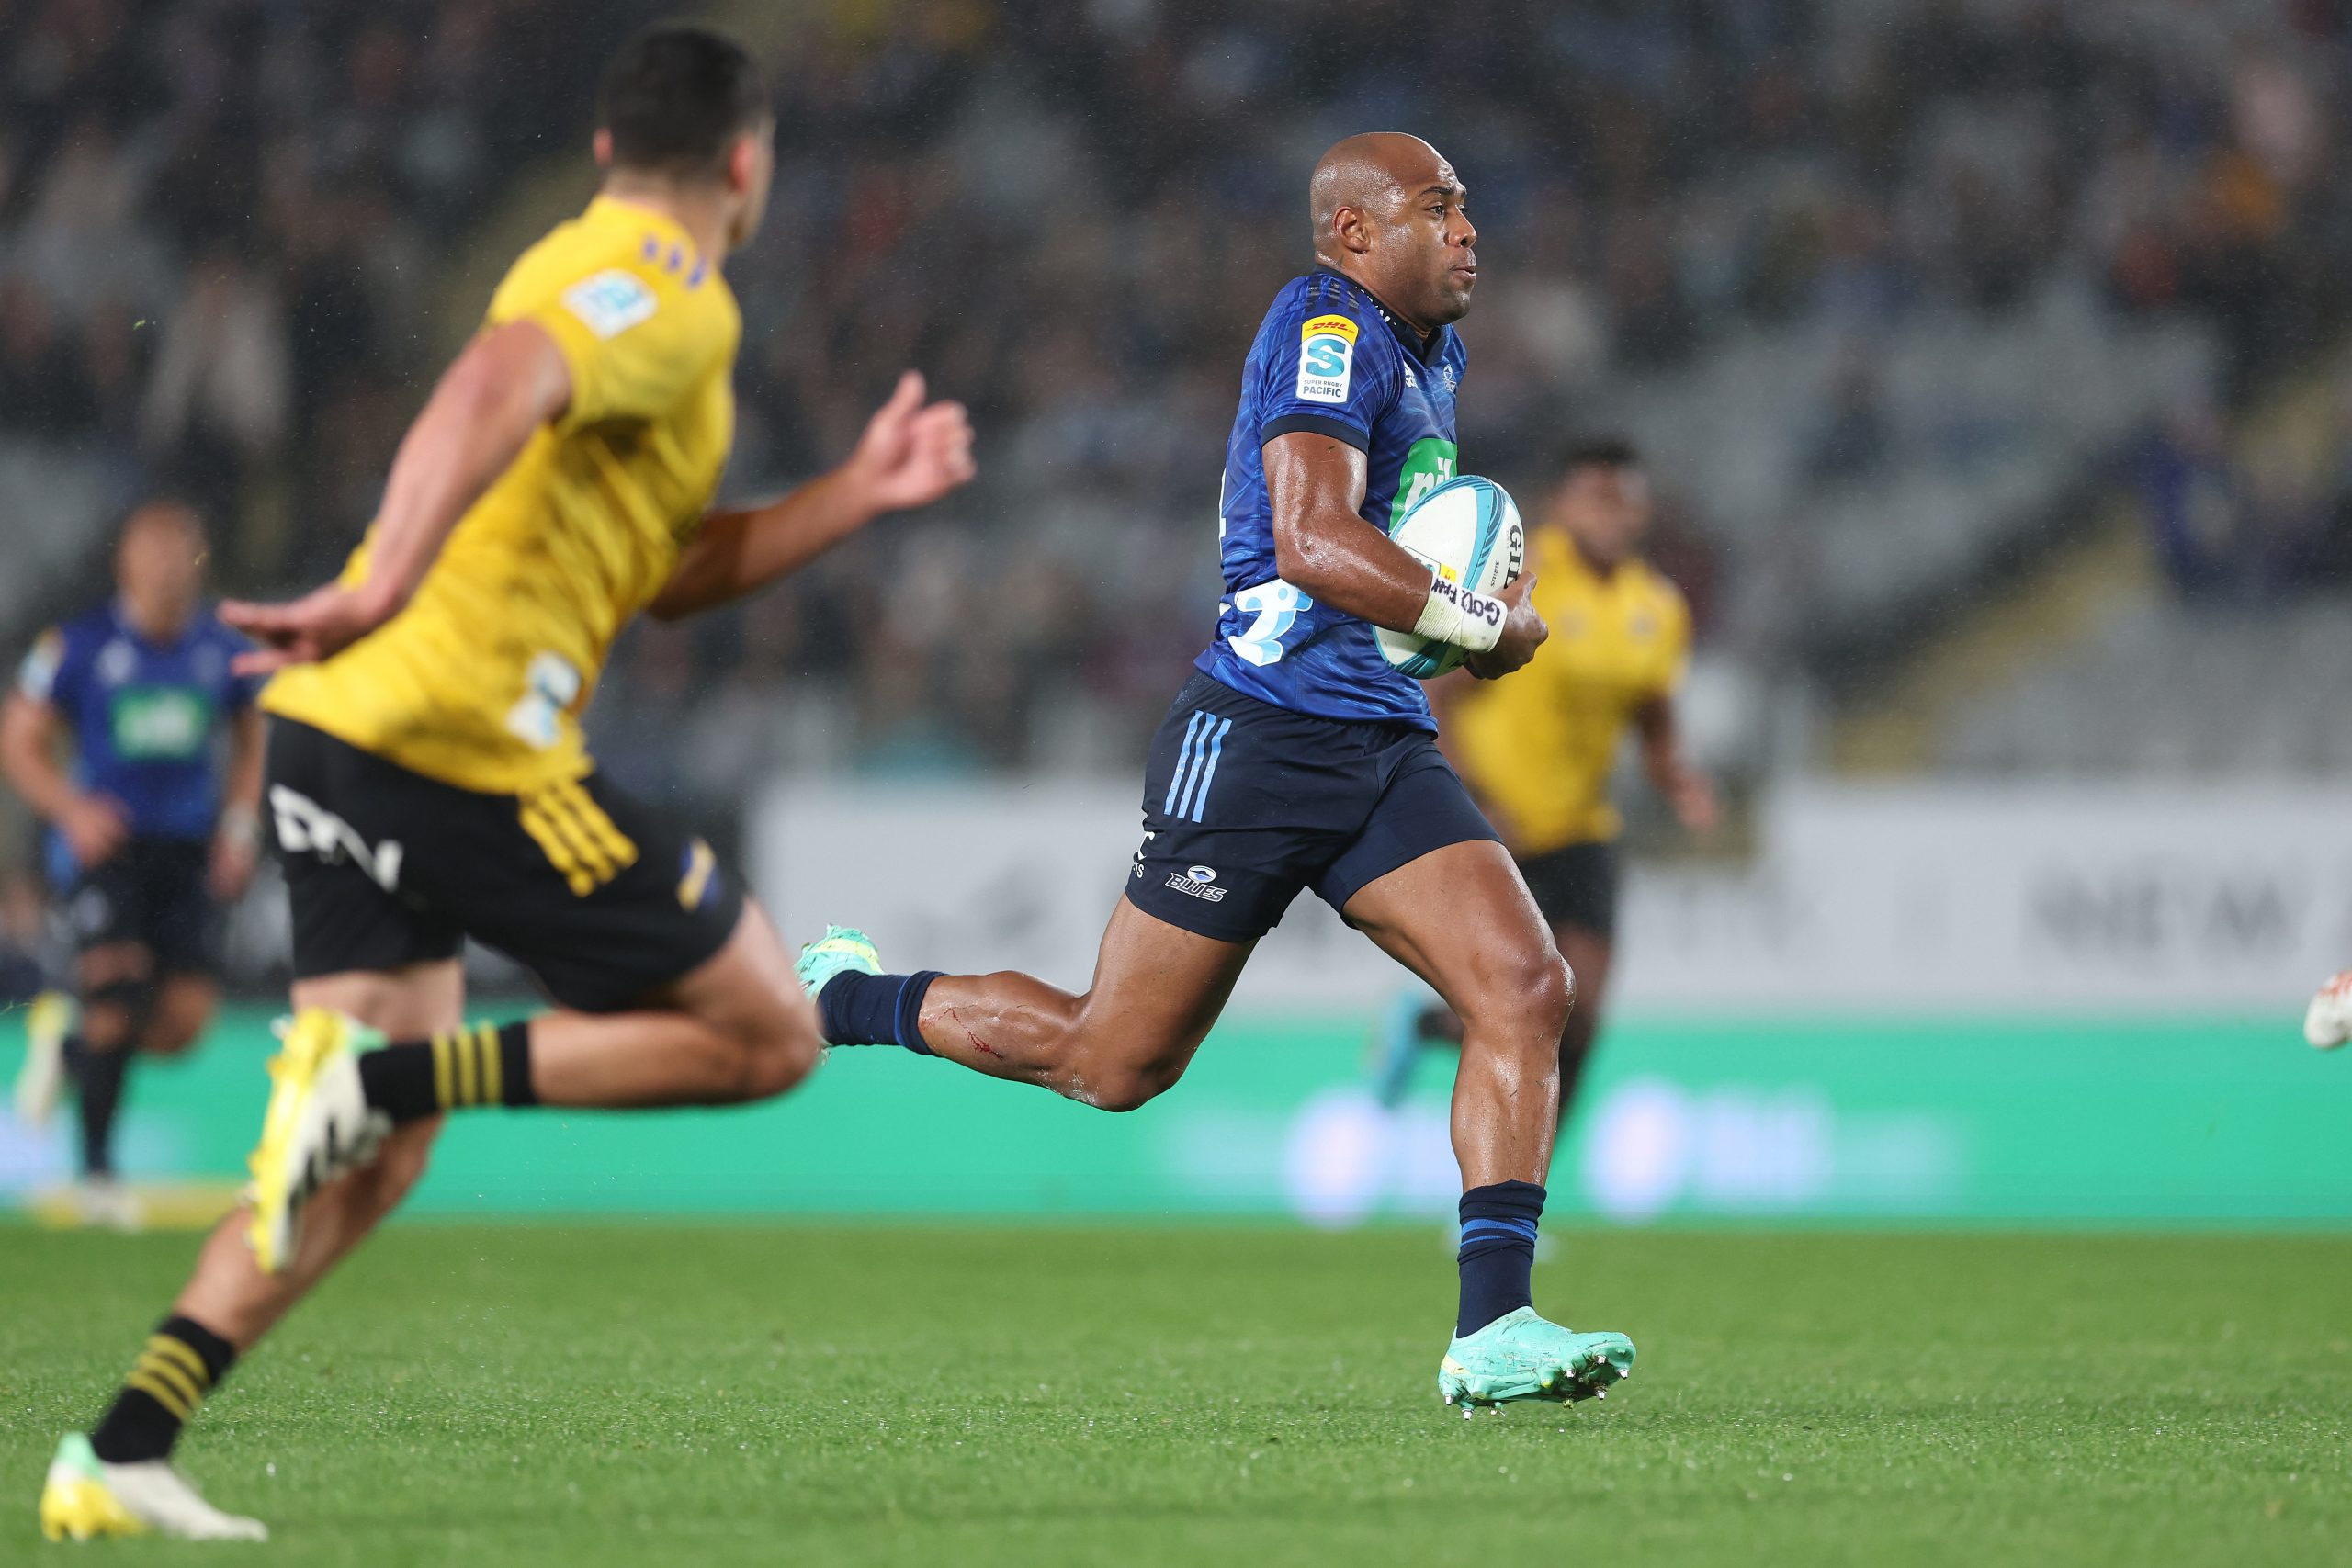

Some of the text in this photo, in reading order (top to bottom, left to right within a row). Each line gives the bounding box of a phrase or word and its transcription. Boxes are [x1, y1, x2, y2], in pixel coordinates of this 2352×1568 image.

[1312, 321, 1349, 332] DHL
[1303, 385, 1342, 398] PACIFIC
[1165, 872, 1228, 902] BLUES
